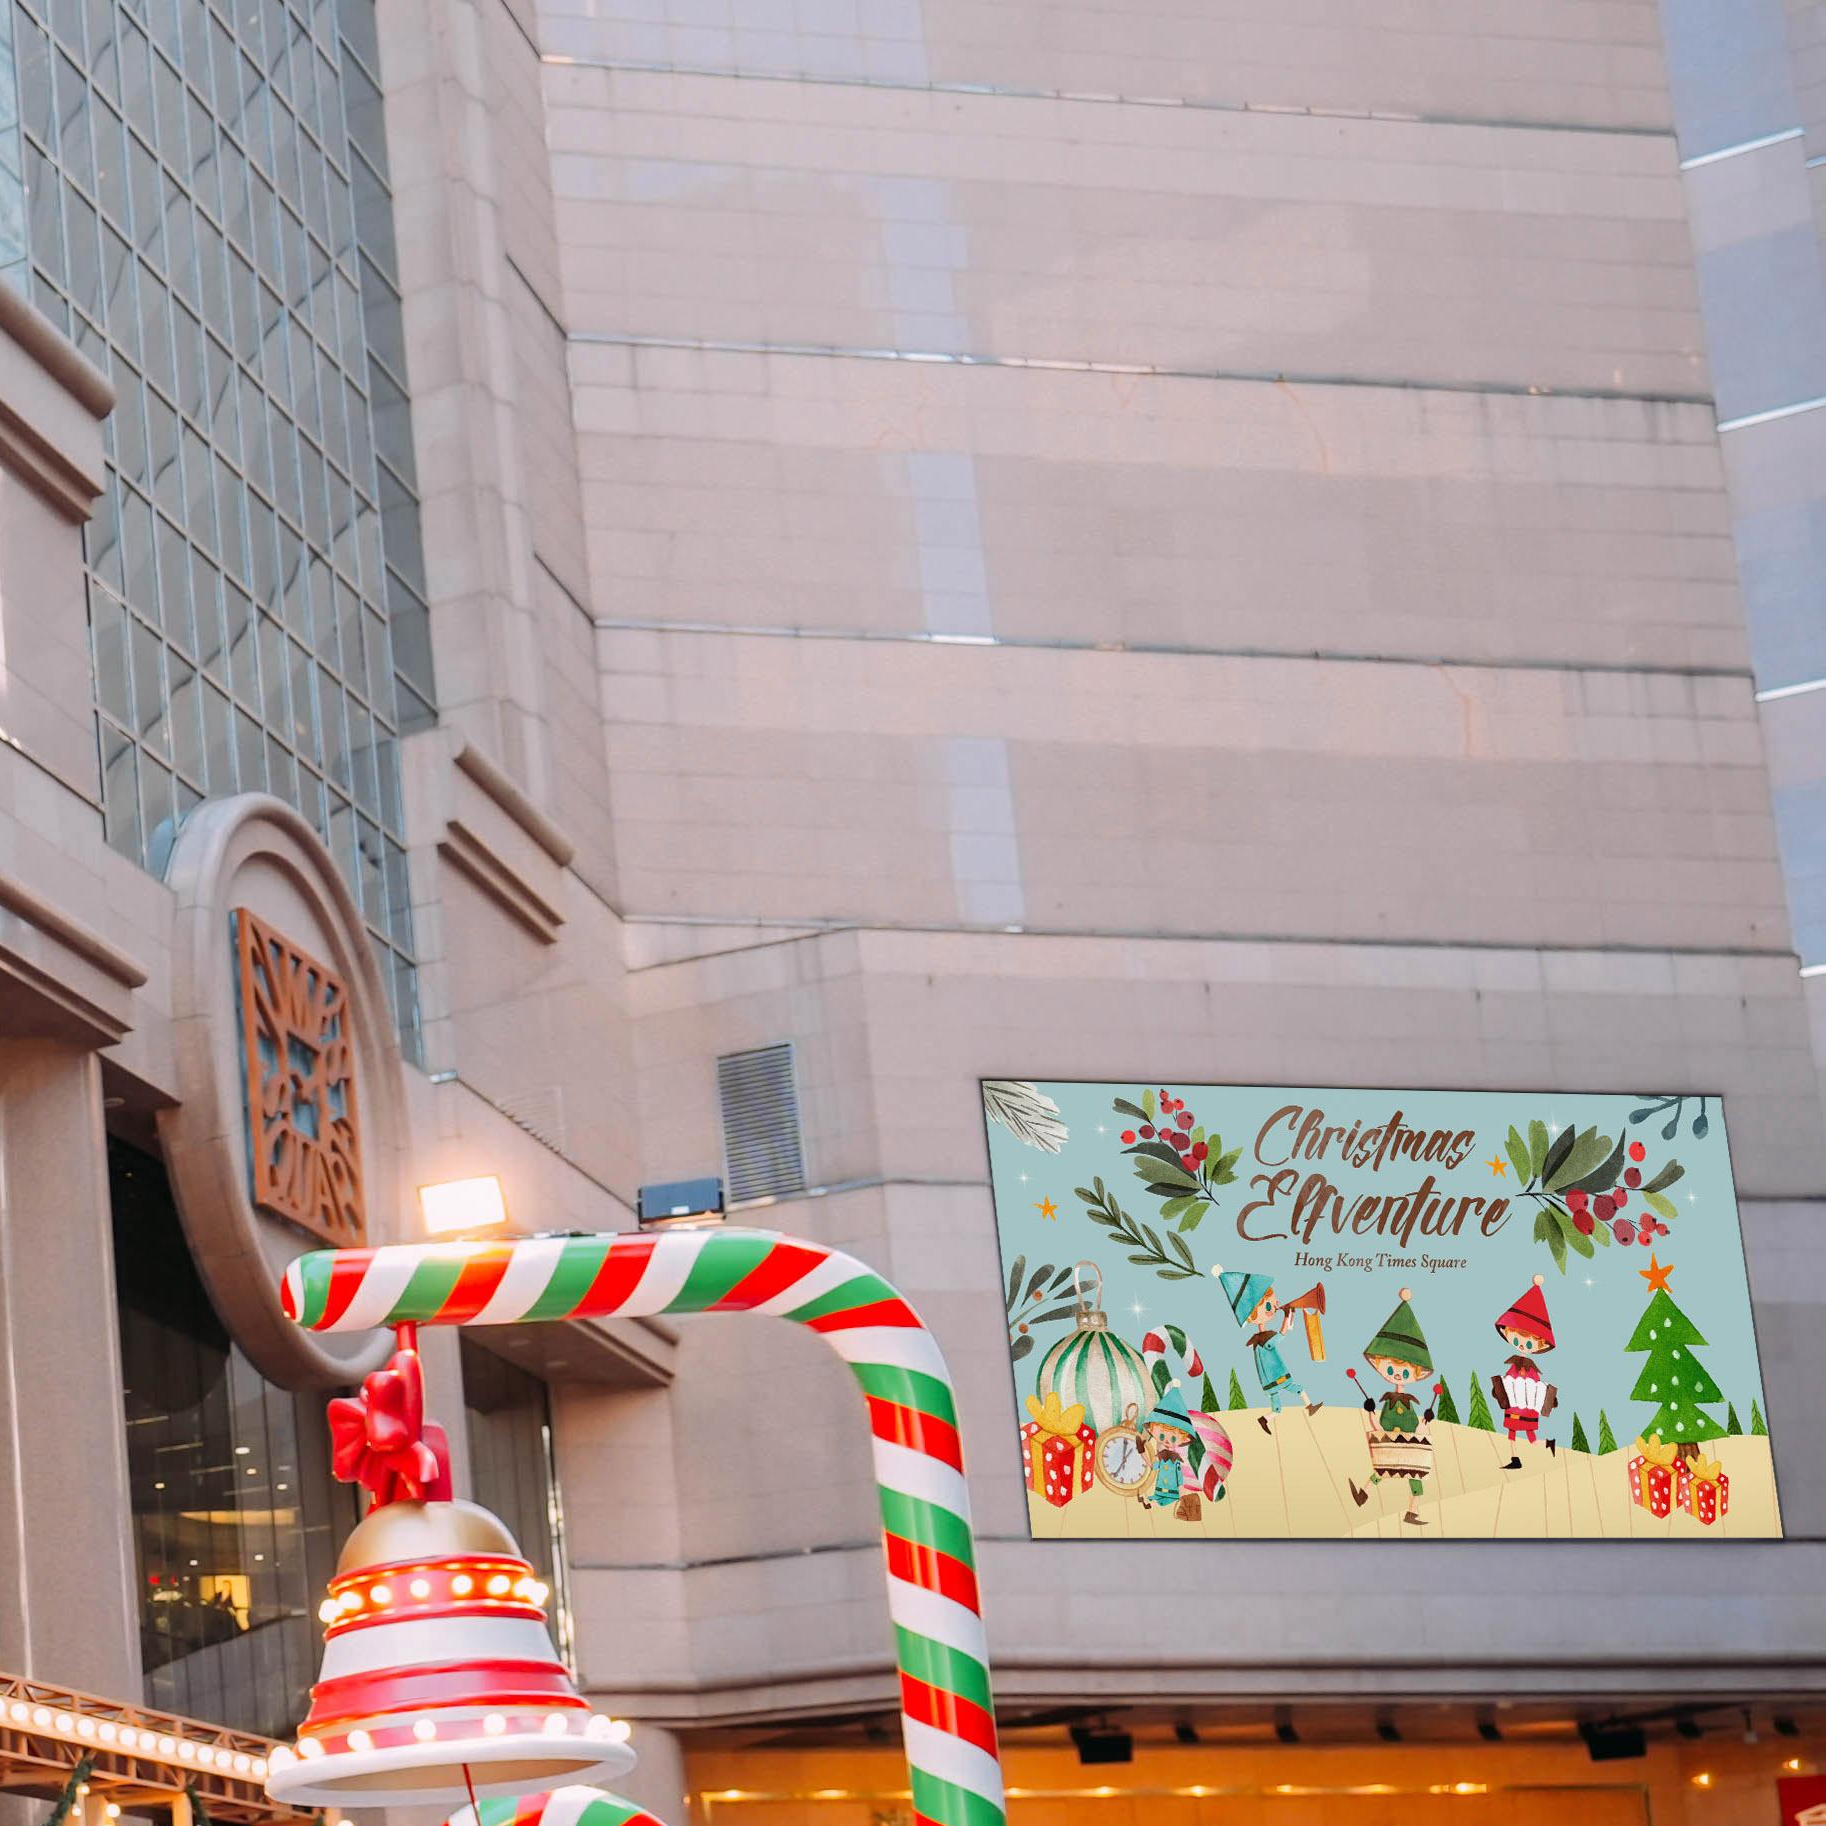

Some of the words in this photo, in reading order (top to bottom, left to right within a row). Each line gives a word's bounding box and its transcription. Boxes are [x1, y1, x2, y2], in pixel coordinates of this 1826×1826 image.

[1252, 1104, 1476, 1171] Christmas
[1236, 1169, 1512, 1248] Elfventure
[1293, 1250, 1330, 1271] Hong
[1334, 1251, 1374, 1273] Kong
[1376, 1252, 1418, 1269] Times
[1421, 1253, 1468, 1272] Square
